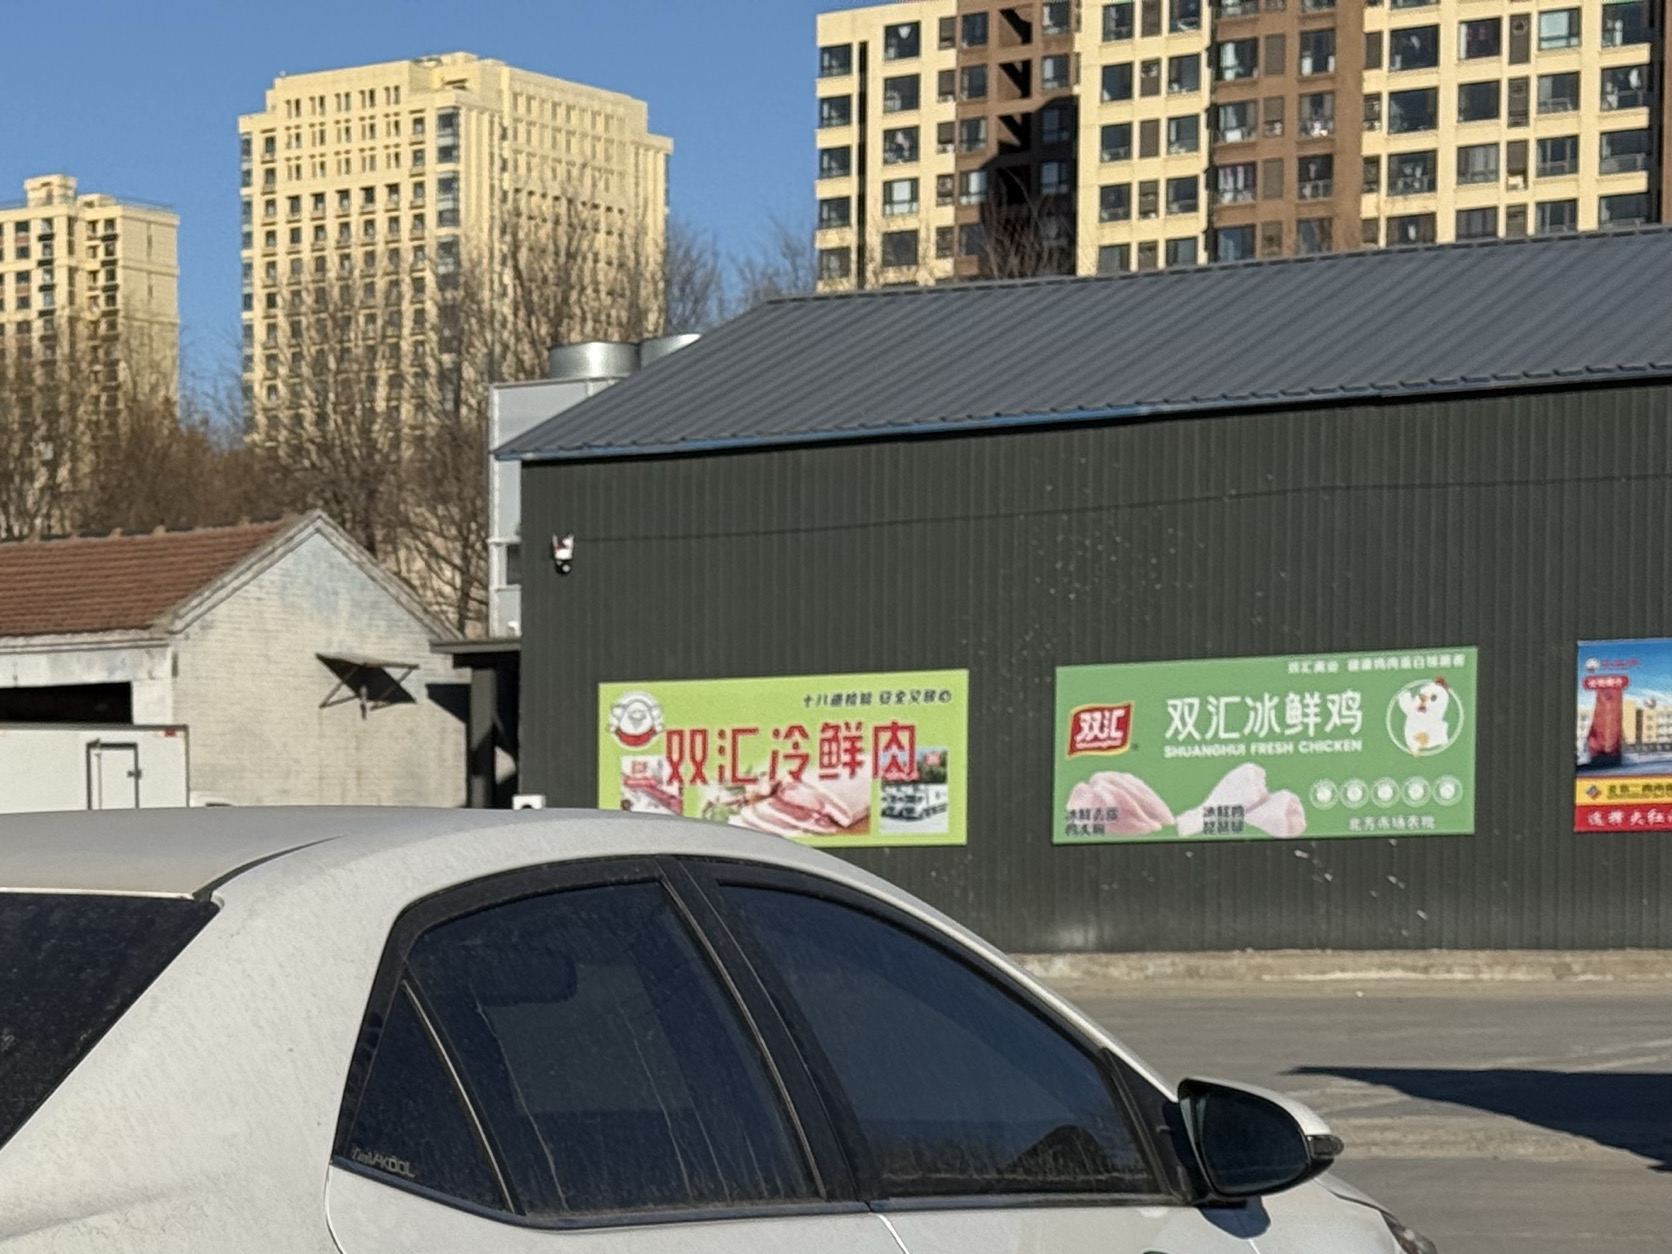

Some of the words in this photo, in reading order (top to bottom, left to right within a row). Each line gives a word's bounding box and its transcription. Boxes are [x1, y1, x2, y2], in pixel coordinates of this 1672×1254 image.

[1074, 709, 1125, 741] 双汇
[1165, 690, 1363, 741] 双汇冰鲜鸡
[665, 721, 918, 784] 双汇冷鲜肉
[1164, 743, 1246, 758] SHUANGHUI
[1251, 742, 1294, 756] FRESH
[1299, 740, 1362, 754] CHICKEN
